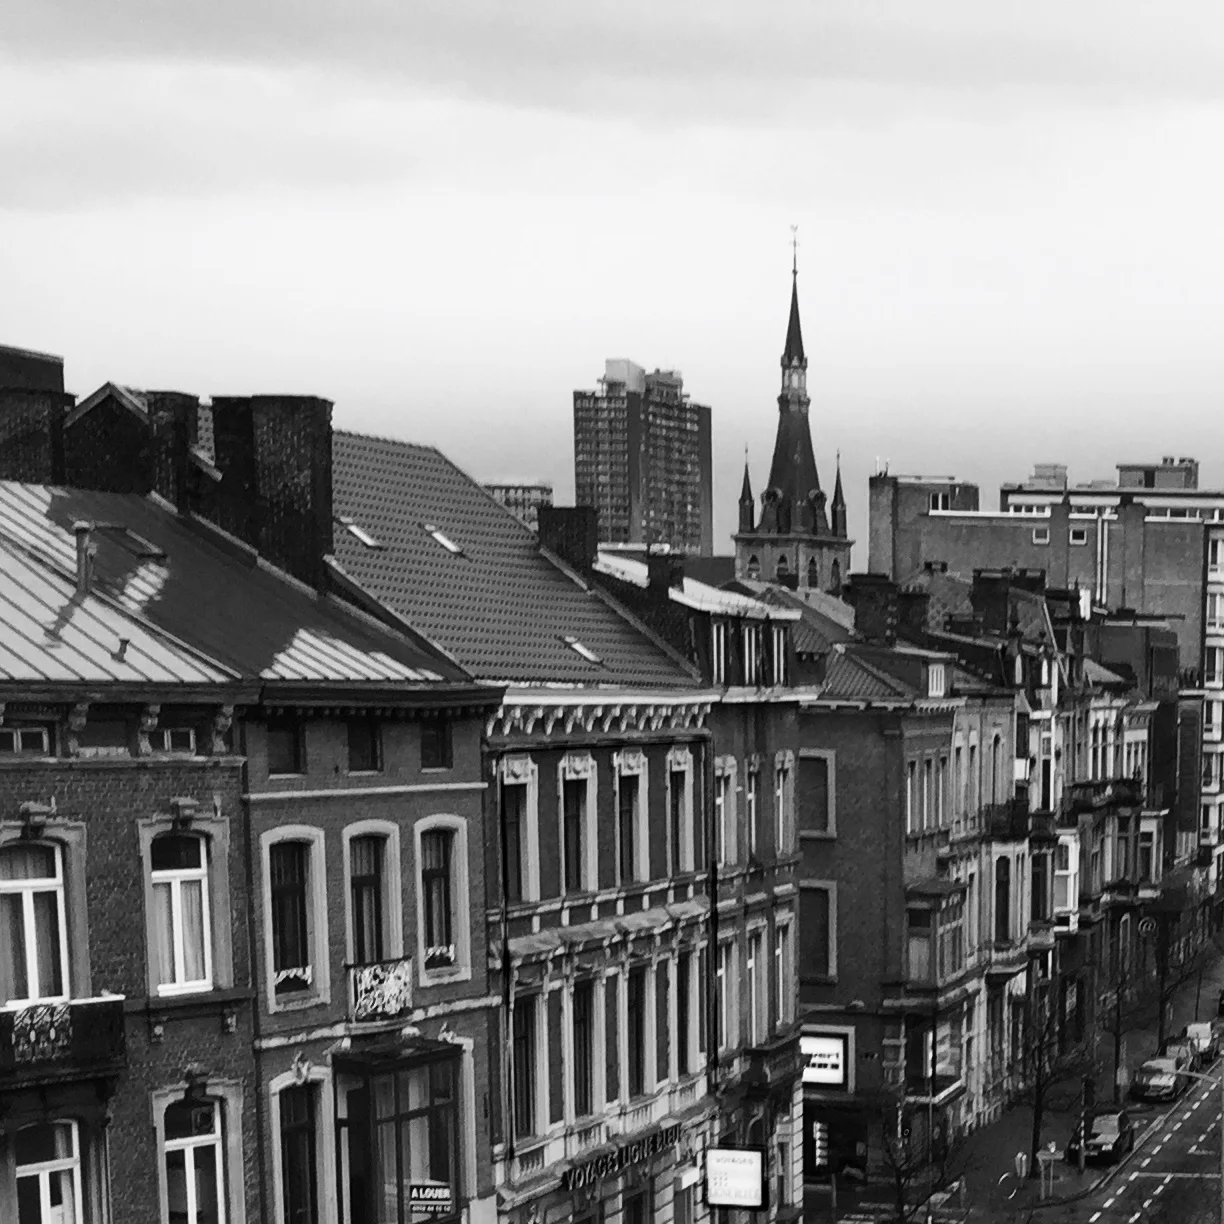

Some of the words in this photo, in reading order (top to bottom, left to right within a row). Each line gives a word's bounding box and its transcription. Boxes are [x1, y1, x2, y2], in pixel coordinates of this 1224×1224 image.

[567, 1150, 619, 1192] VOYAGES
[622, 1135, 654, 1168] LIGNE
[411, 1187, 419, 1199] A
[419, 1187, 451, 1199] LOUER
